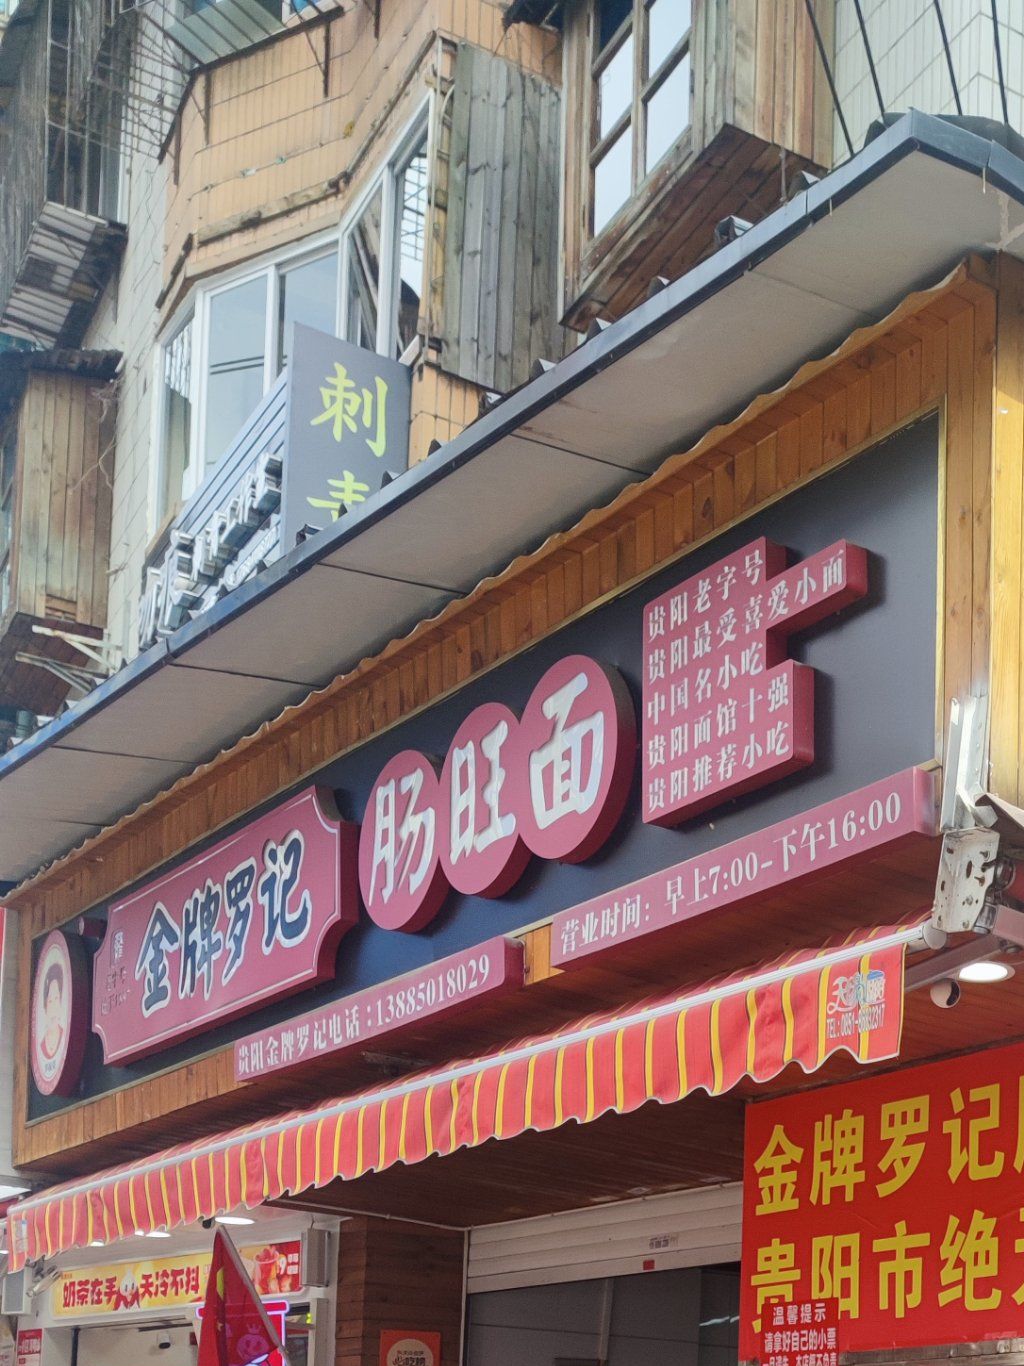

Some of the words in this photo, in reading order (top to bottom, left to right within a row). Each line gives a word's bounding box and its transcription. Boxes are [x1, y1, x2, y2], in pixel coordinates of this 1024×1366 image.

[648, 549, 764, 643] 贵阳老字号
[648, 549, 845, 686] 贵阳最受喜爱小面
[647, 641, 764, 726] 中国名小吃
[647, 672, 789, 770] 贵阳面馆十强
[368, 672, 604, 906] 肠旺面
[647, 721, 789, 813] 贵阳推荐小吃
[134, 829, 312, 1018] 金牌罗记
[62, 1276, 118, 1308] 奶茶在手
[772, 1302, 827, 1326] 温馨提示
[764, 1327, 837, 1354] 请拿好自己的小票
